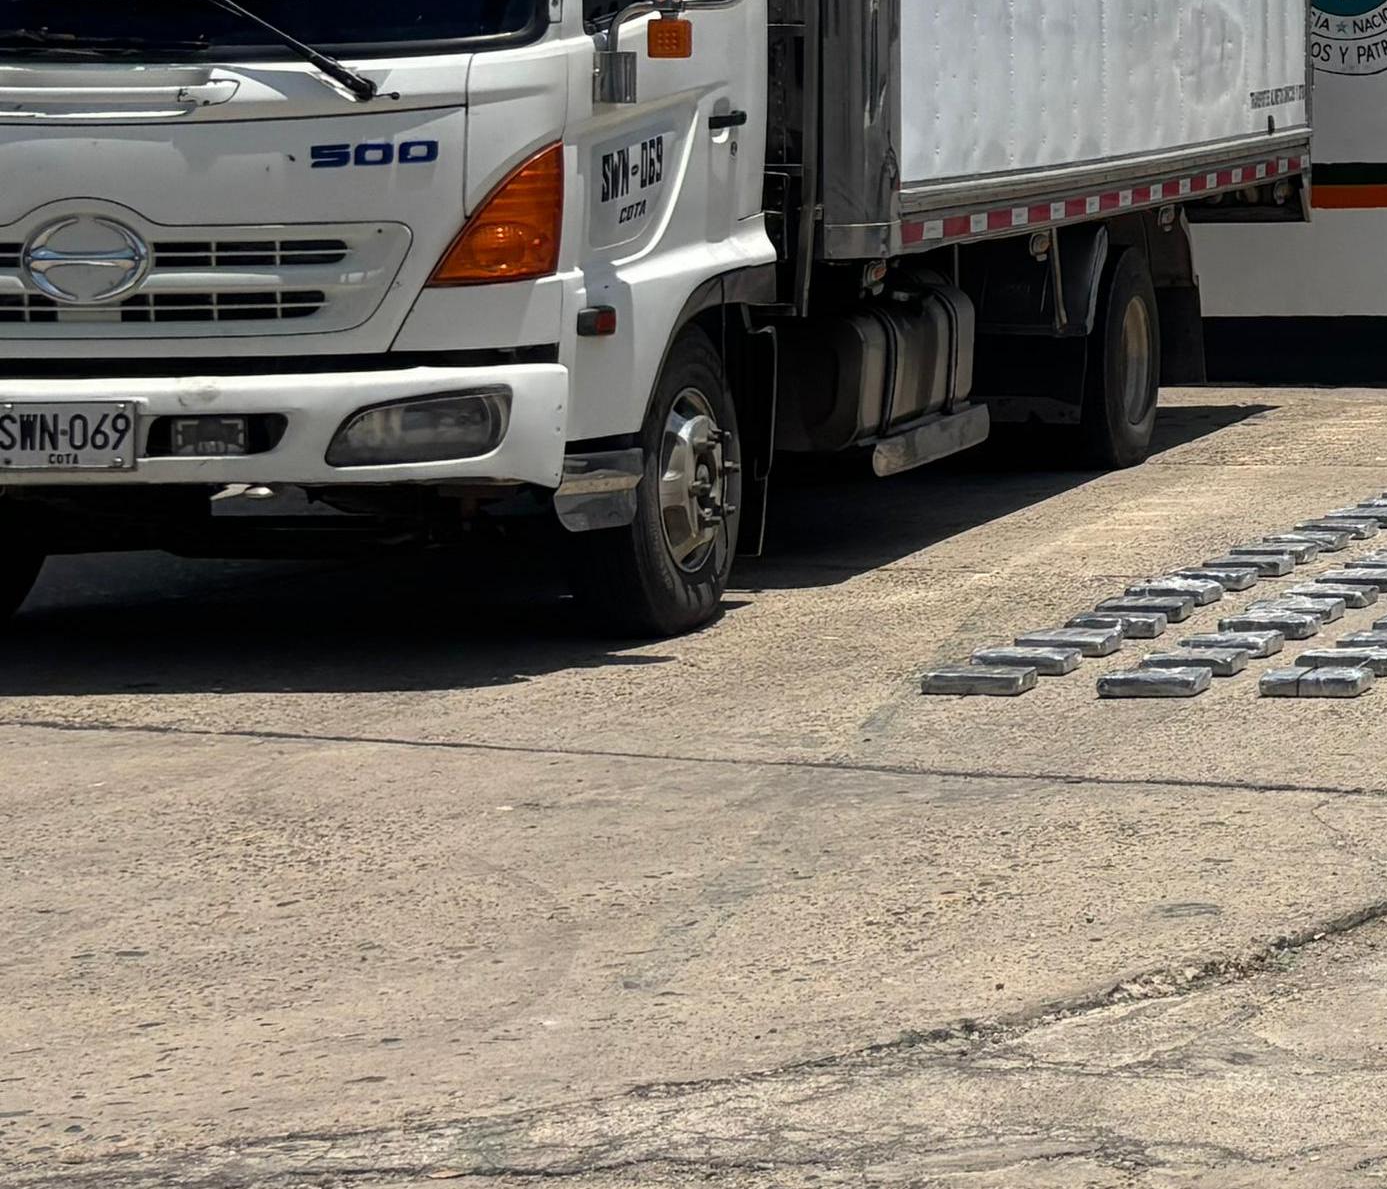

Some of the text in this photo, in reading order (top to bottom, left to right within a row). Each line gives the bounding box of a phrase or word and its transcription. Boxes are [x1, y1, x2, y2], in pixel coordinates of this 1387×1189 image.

[1340, 46, 1349, 64] Y
[310, 140, 438, 169] 500
[0, 413, 131, 451] SWN-069
[48, 453, 79, 465] COTA
